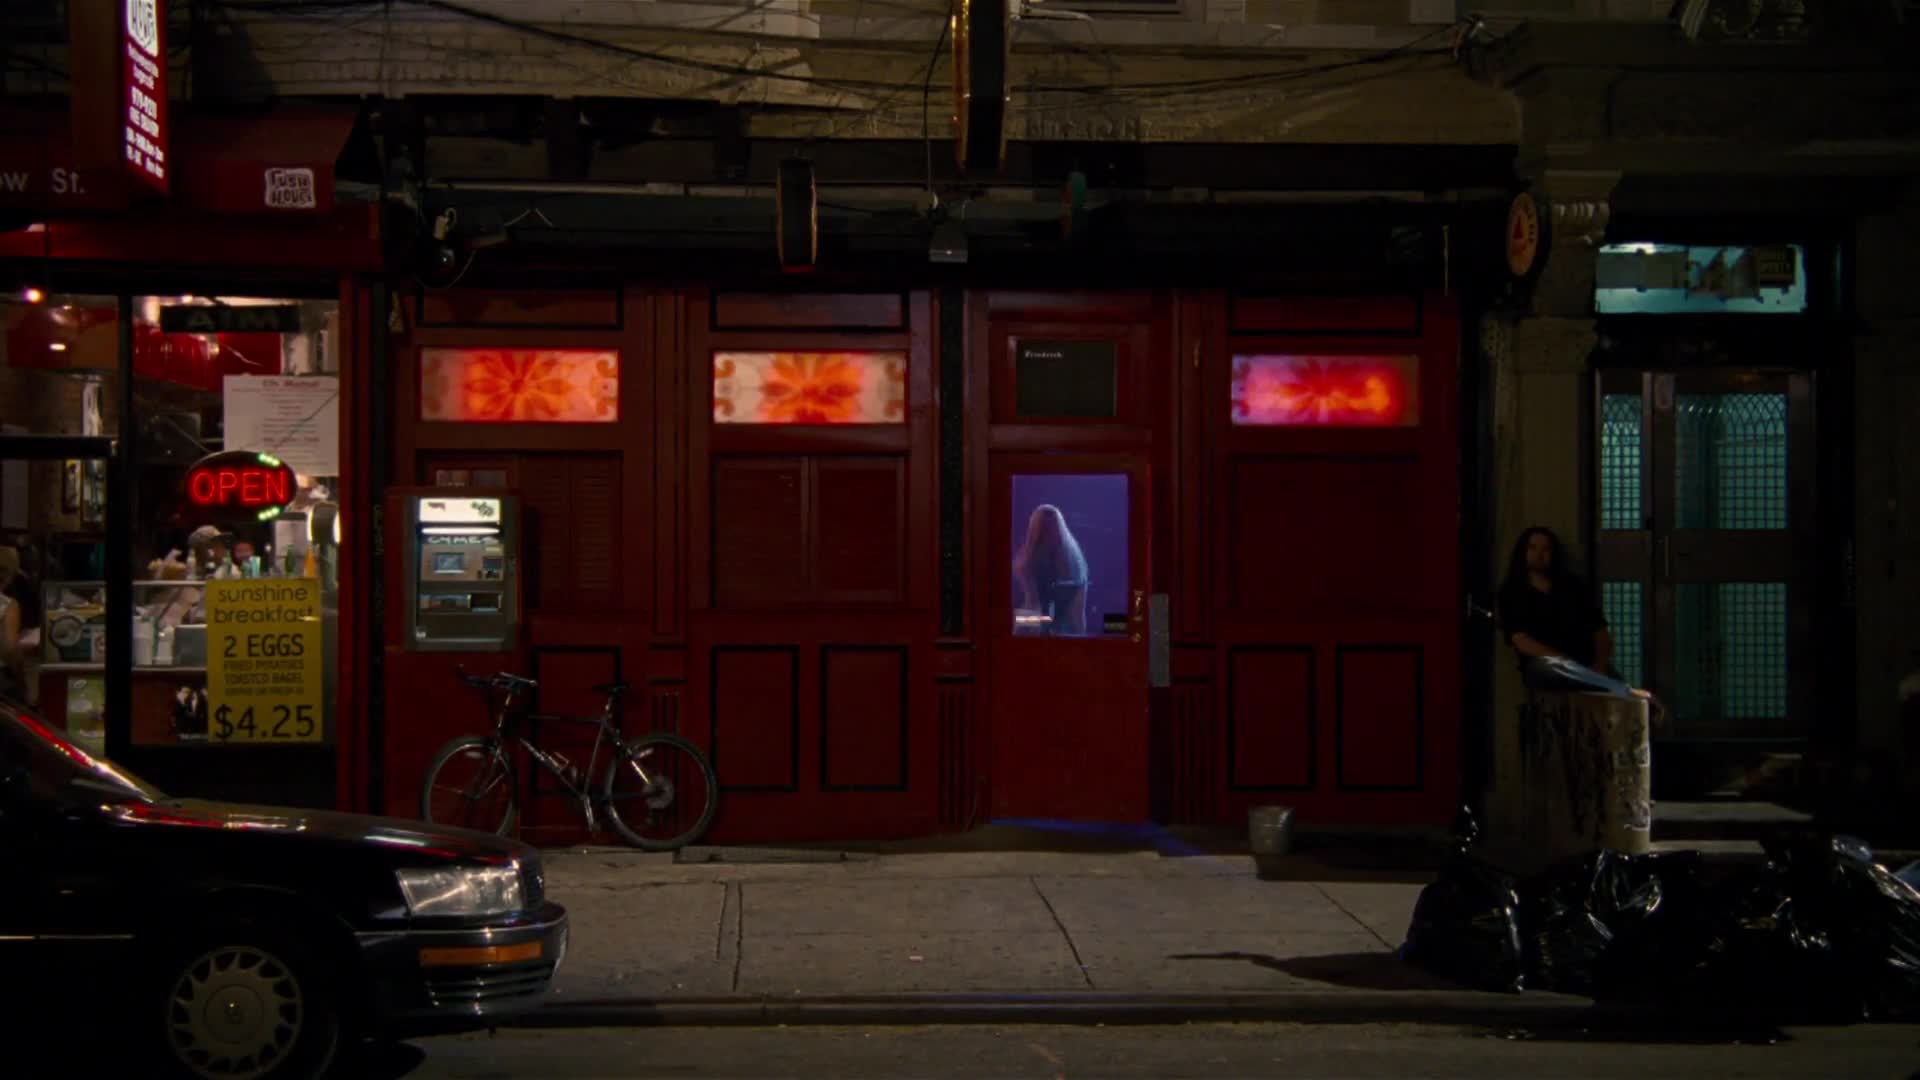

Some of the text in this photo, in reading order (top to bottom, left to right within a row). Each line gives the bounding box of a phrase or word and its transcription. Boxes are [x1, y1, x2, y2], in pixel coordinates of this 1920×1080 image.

[0, 167, 86, 194] w St.
[193, 471, 284, 502] OPEN
[217, 583, 308, 603] sunshine
[214, 605, 313, 623] breakfast
[223, 633, 304, 658] 2 EGGS
[214, 704, 314, 739] $4.25
